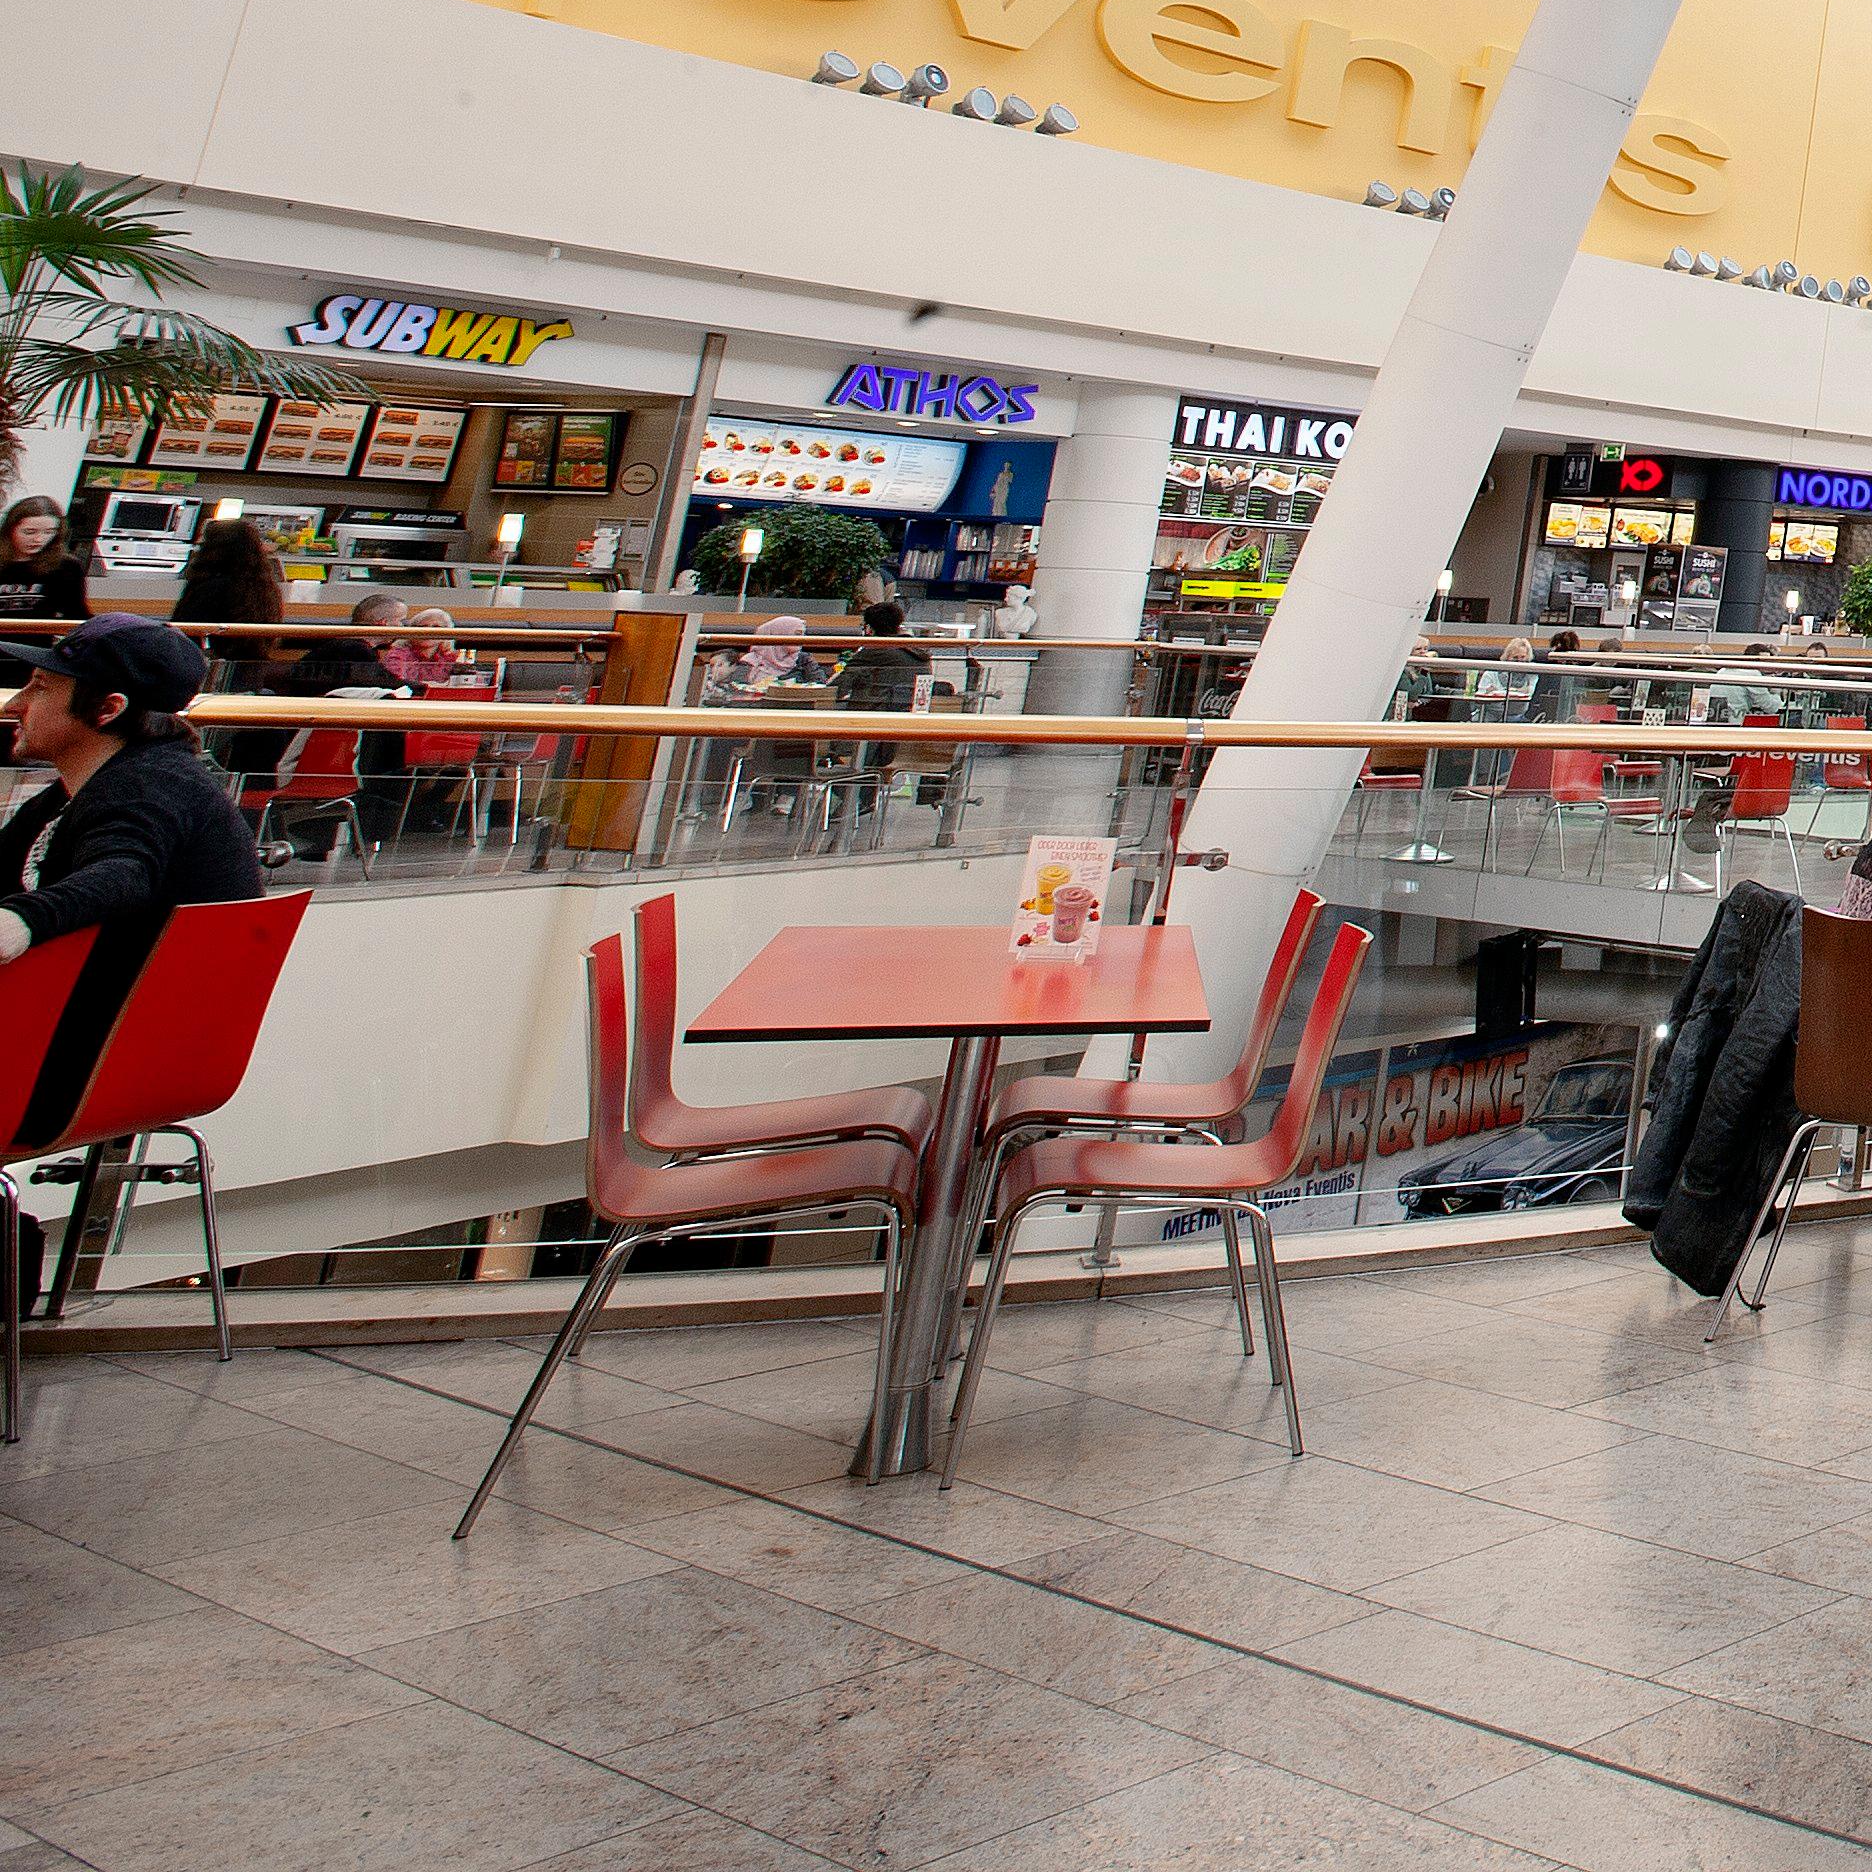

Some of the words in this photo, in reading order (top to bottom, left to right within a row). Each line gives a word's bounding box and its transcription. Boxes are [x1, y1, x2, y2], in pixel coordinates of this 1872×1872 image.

[288, 294, 576, 367] SUBWAY
[827, 363, 1040, 424] ATHOS
[1182, 405, 1285, 454] THAI
[1276, 1084, 1373, 1177] AR
[1376, 1074, 1420, 1158] &
[1424, 1050, 1530, 1147] BIKE
[1305, 1171, 1356, 1197] Eventis
